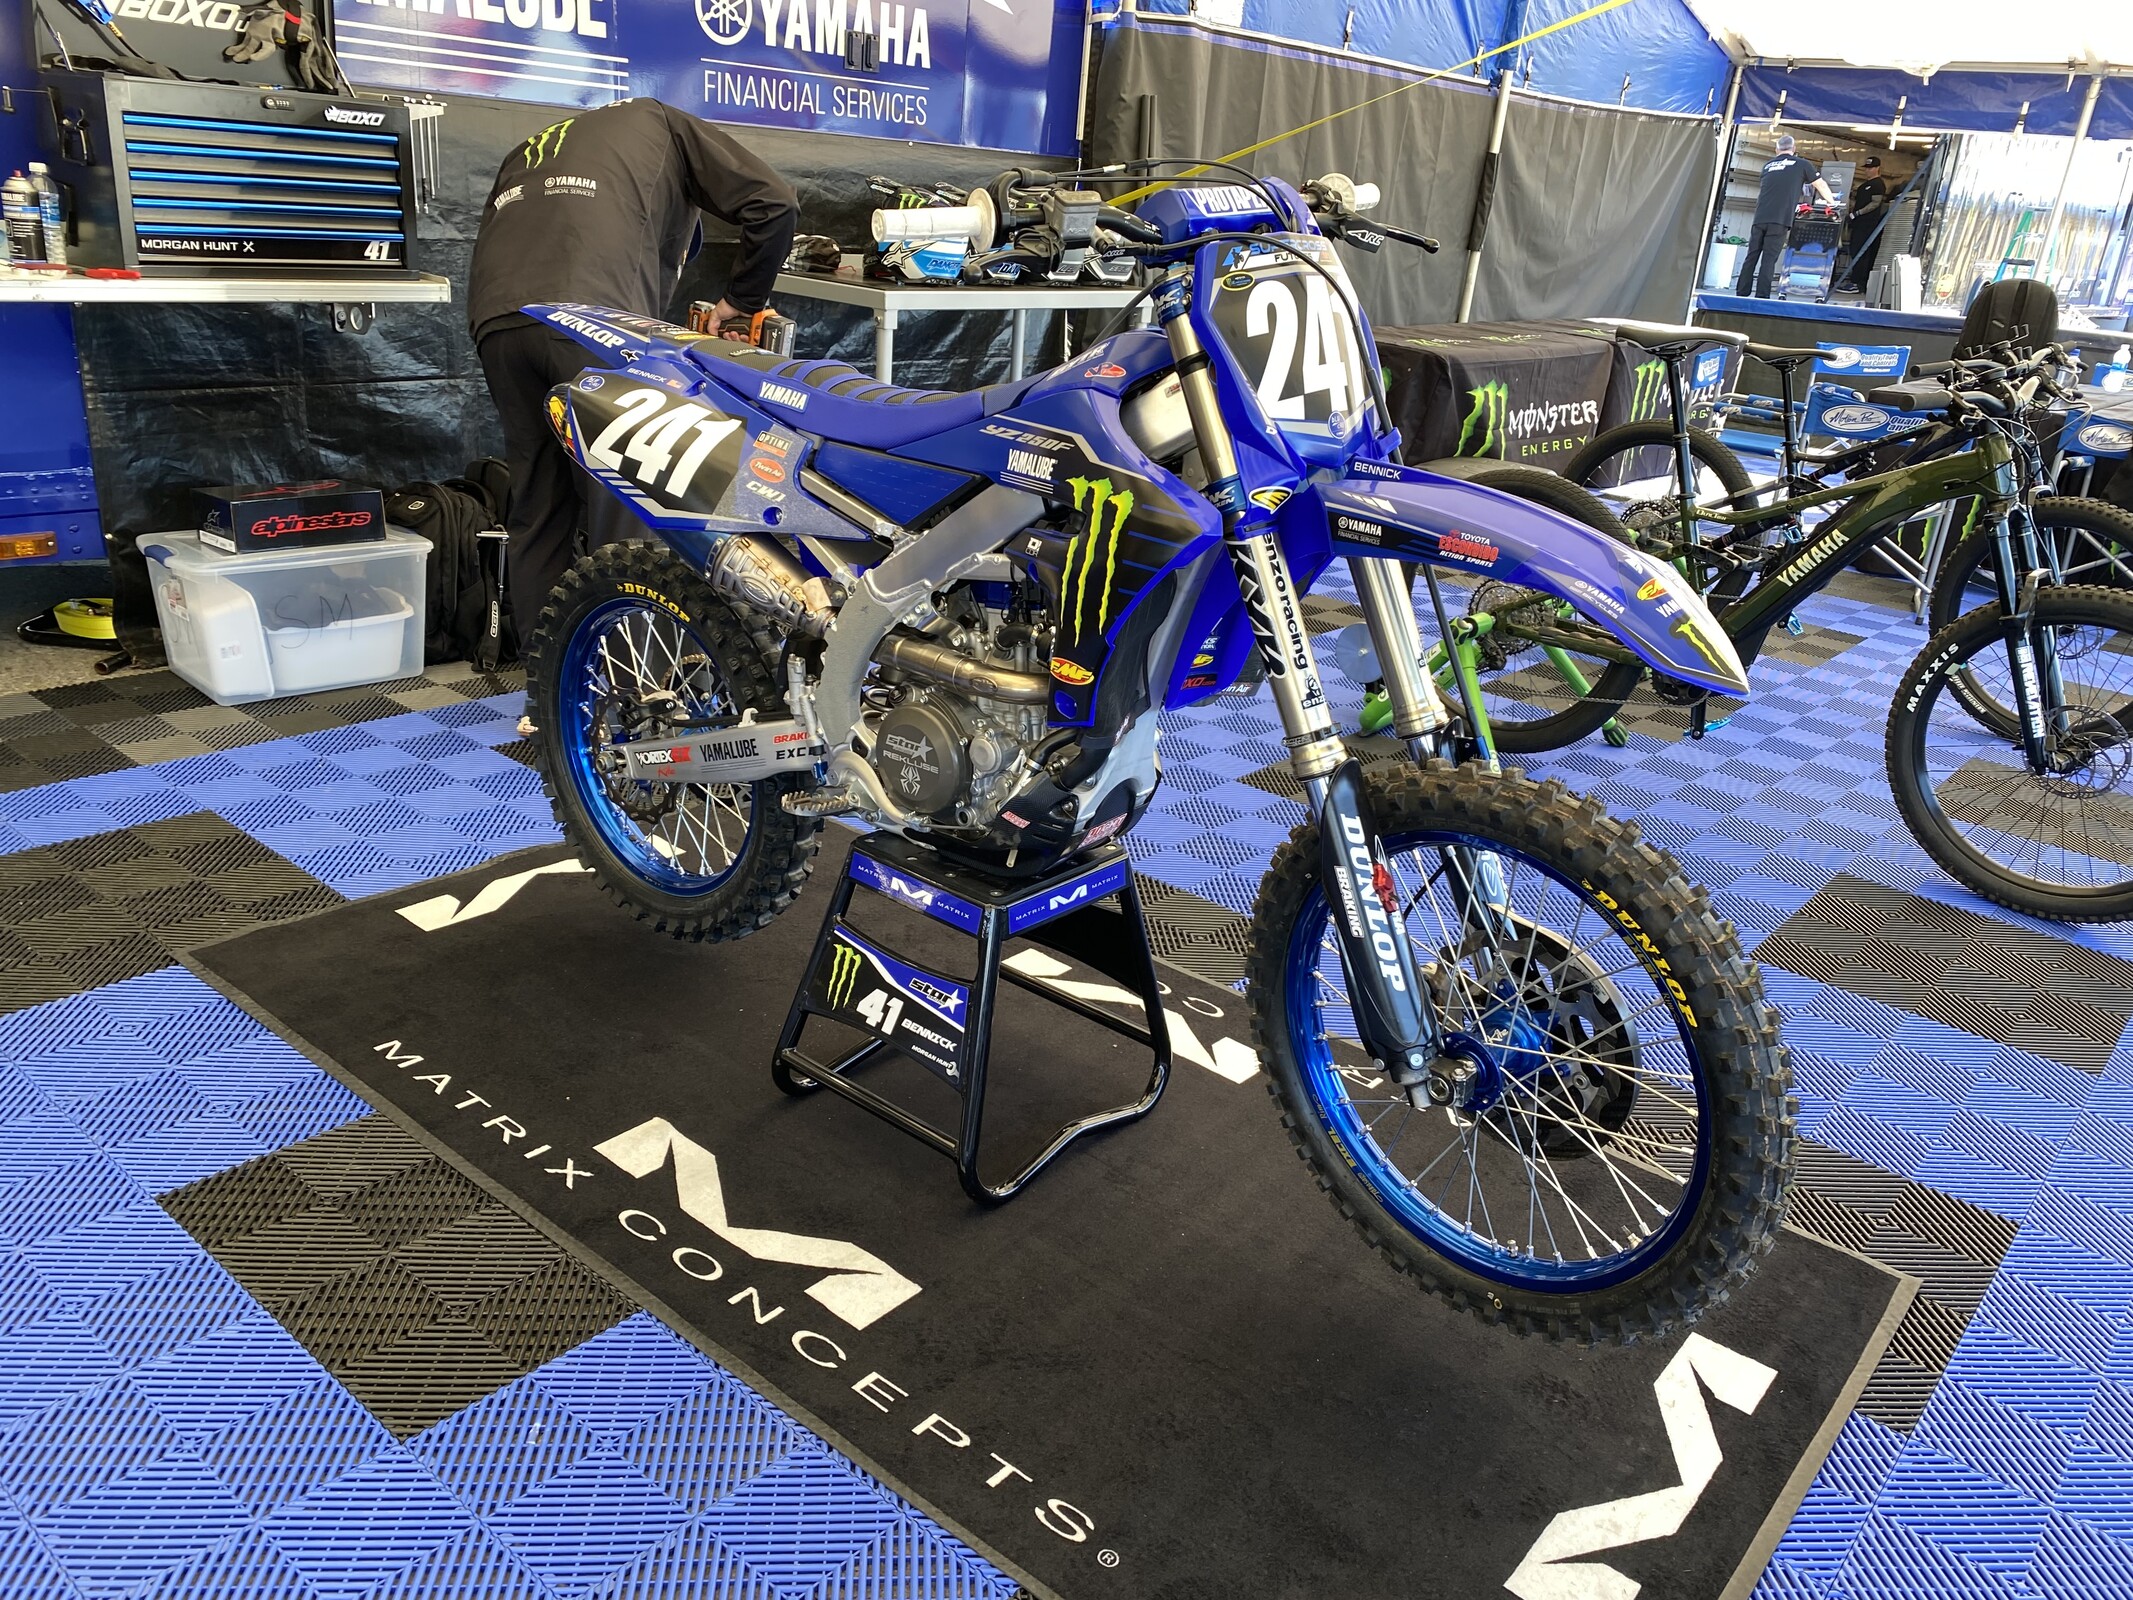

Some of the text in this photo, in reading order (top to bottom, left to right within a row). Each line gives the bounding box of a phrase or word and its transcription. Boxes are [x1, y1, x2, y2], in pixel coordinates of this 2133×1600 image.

[761, 0, 931, 69] YAMAHA
[704, 70, 928, 126] FINANCIAL SERVICES
[337, 110, 386, 126] BOXO
[556, 176, 597, 190] YAMAHA
[570, 188, 595, 198] SERVICES
[141, 239, 239, 251] MORGAN HUNT
[1347, 229, 1385, 246] ARC
[363, 241, 391, 260] 41
[547, 311, 627, 349] DUNLOP
[627, 367, 667, 383] BENNICK
[760, 382, 808, 410] YAMAHA
[589, 388, 742, 499] 241
[758, 432, 790, 451] OPTIMA
[1522, 435, 1588, 457] ENERGY
[755, 461, 772, 474] Twin
[1007, 449, 1057, 480] YAMALUBE
[1353, 462, 1402, 481] BENNICK
[251, 511, 372, 537] alpinestars
[1348, 519, 1382, 537] YAMAHA
[1337, 530, 1381, 546] FINANCIAL SERVICES
[1438, 535, 1500, 561] ESCONDIDO
[1460, 532, 1491, 546] TOYOTA
[1439, 550, 1494, 568] ACTION SPORTS
[1776, 528, 1850, 588] YAMAHA
[624, 583, 691, 623] DUNLOP
[1587, 586, 1627, 615] YAMAHA
[1051, 658, 1094, 682] FMF
[1906, 643, 1960, 713] MAXXIS
[1302, 696, 1326, 709] enz
[700, 738, 759, 763] YAMALUBE
[773, 731, 809, 745] BRAKI
[636, 749, 674, 766] VORTEX
[883, 750, 939, 774] REKLUSE
[937, 901, 970, 919] MATRIX
[1015, 905, 1046, 921] MATRIX
[1091, 874, 1119, 888] MATRIX
[1334, 866, 1364, 939] BRAKING
[1340, 813, 1407, 992] DUNLOP
[1593, 890, 1698, 1028] DUNLOP
[1622, 935, 1660, 983] EXCEL
[910, 978, 953, 1003] star
[856, 988, 904, 1036] 41
[901, 1018, 958, 1052] BENNICK
[911, 1045, 937, 1061] MORGAN
[373, 1040, 594, 1190] MATRIX
[1328, 1127, 1357, 1168] EXCEL
